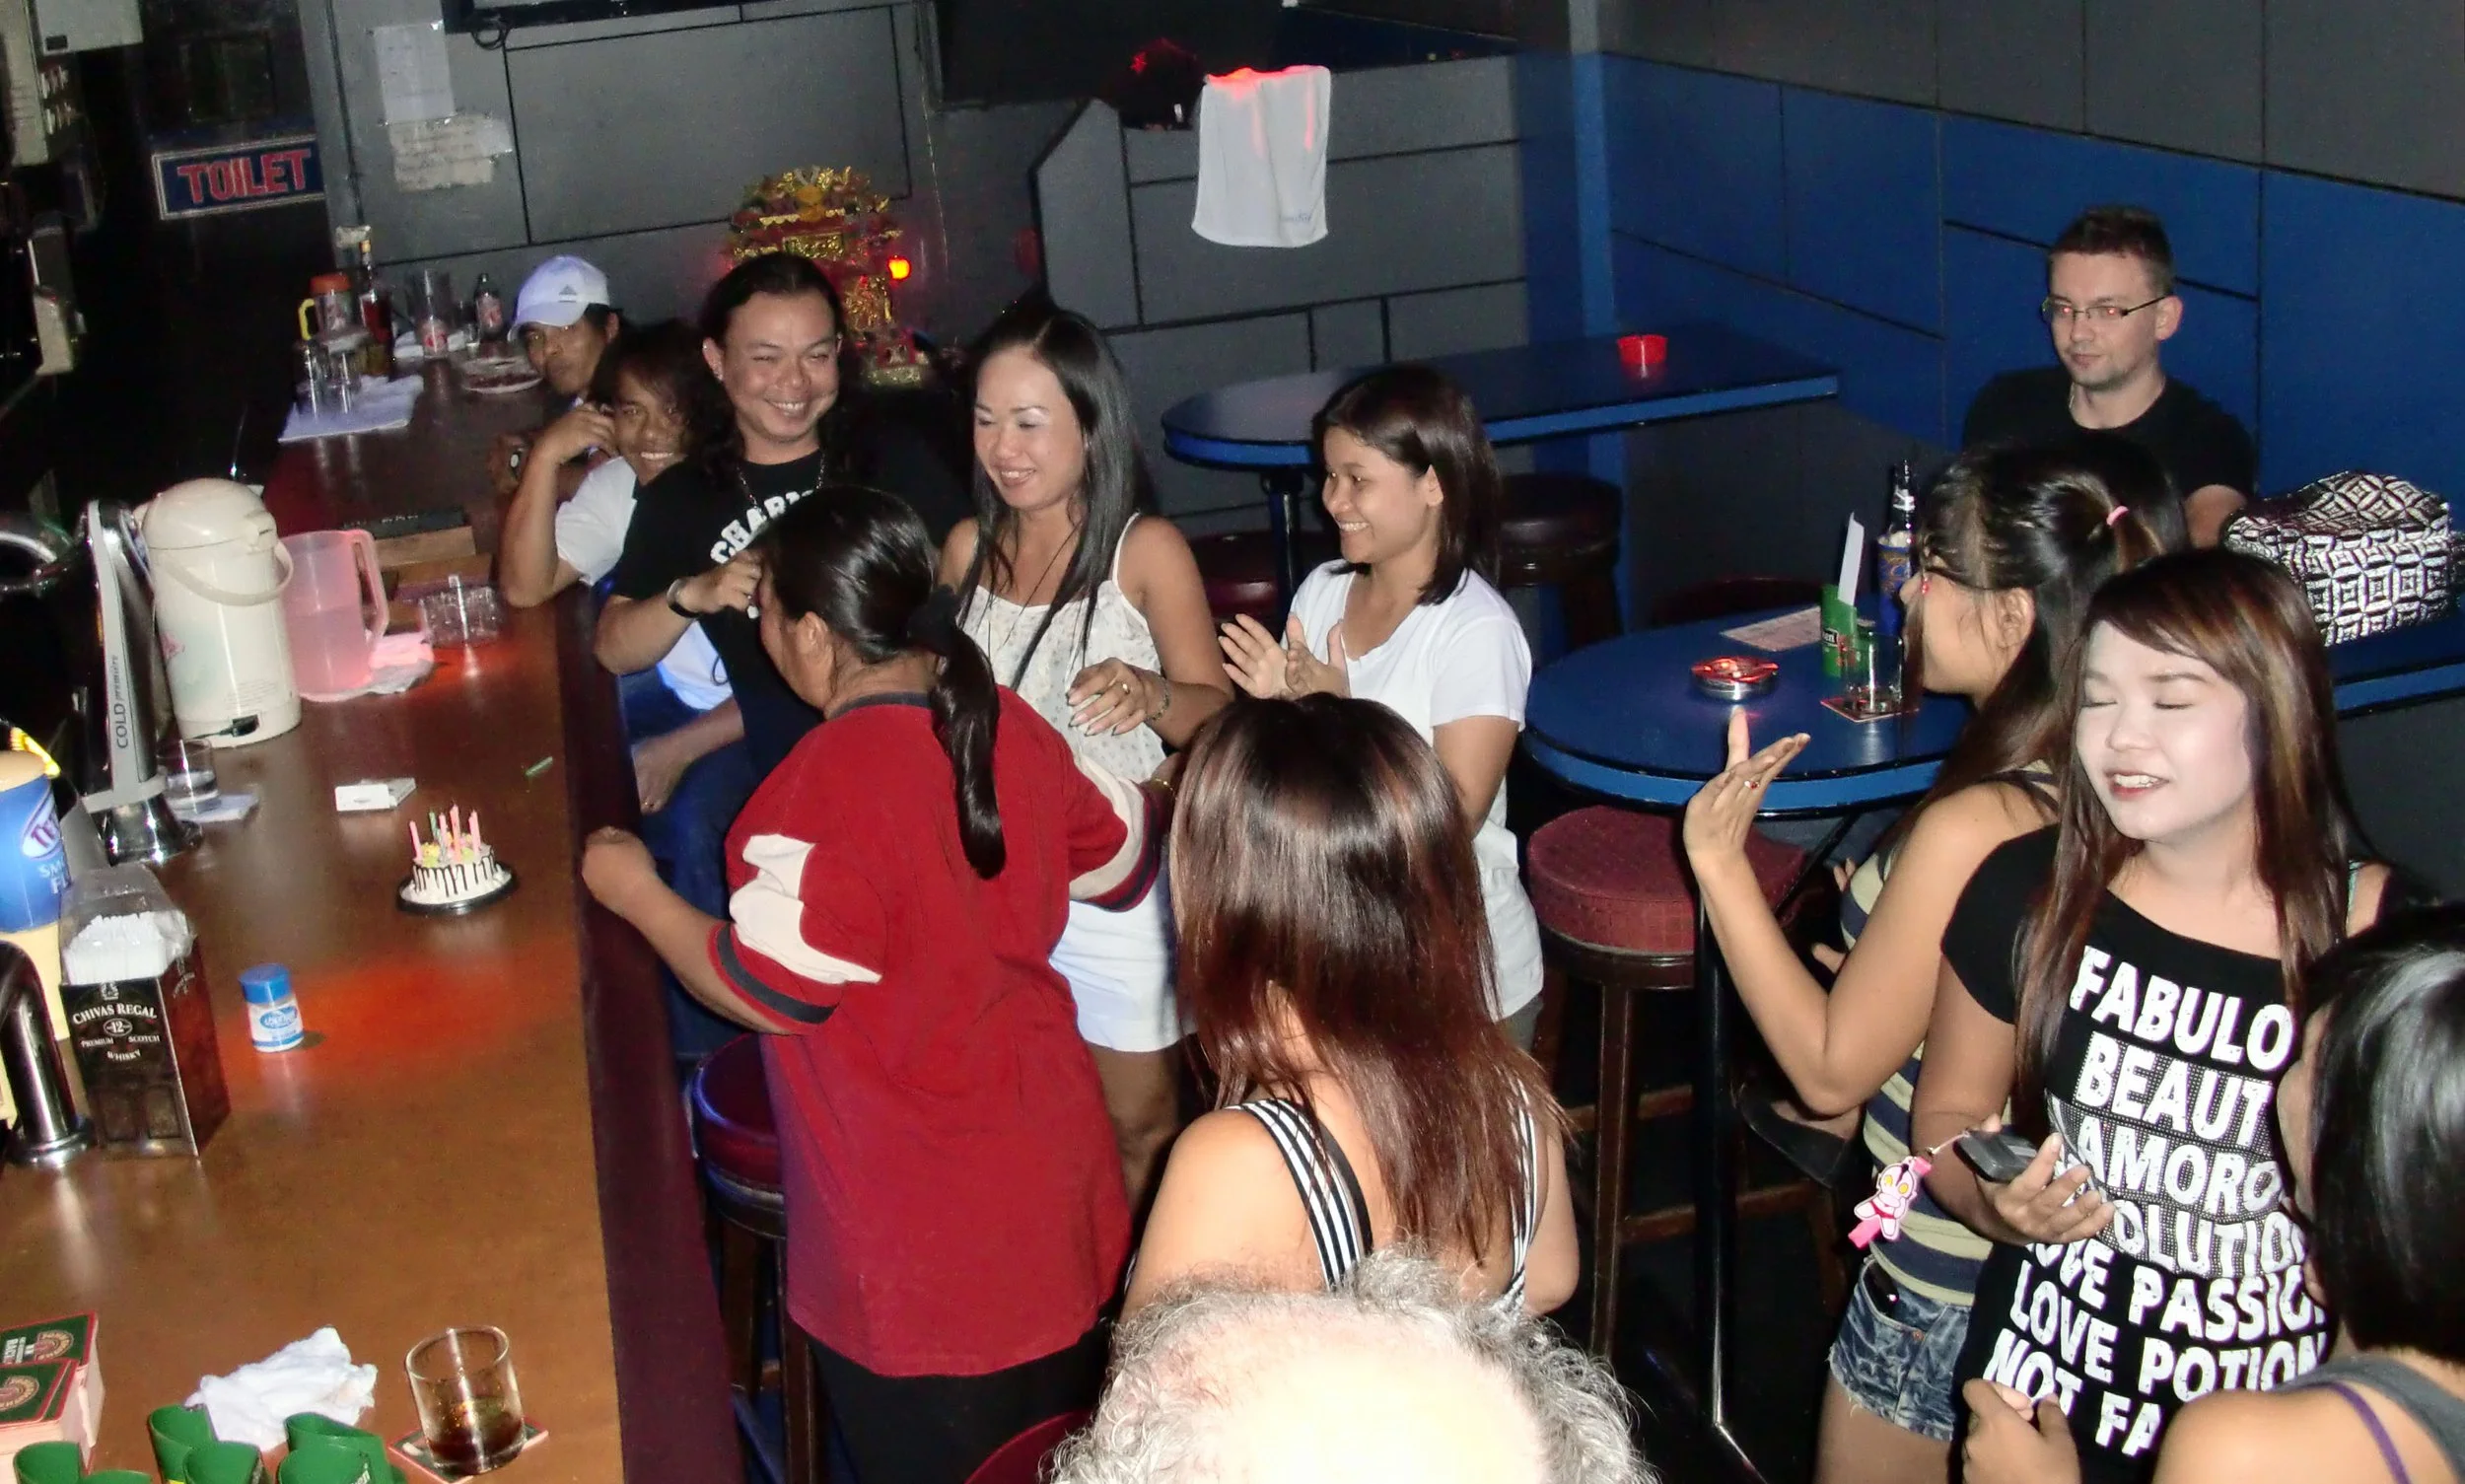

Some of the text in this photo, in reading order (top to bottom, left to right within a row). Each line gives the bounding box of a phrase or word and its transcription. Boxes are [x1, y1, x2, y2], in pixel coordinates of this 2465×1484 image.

[176, 149, 312, 204] TOILET
[113, 703, 128, 749] COLD
[72, 1003, 158, 1025] CHIVAS REGAL
[81, 1034, 161, 1047] PREMIUM SCOTCH
[2069, 945, 2295, 1072] FABULO
[106, 1049, 141, 1061] WHISKY
[2075, 1030, 2274, 1148] BEAUT
[2009, 1259, 2119, 1383] LOVE
[2128, 1263, 2326, 1343] PASSIO
[1982, 1328, 2082, 1418] NOT
